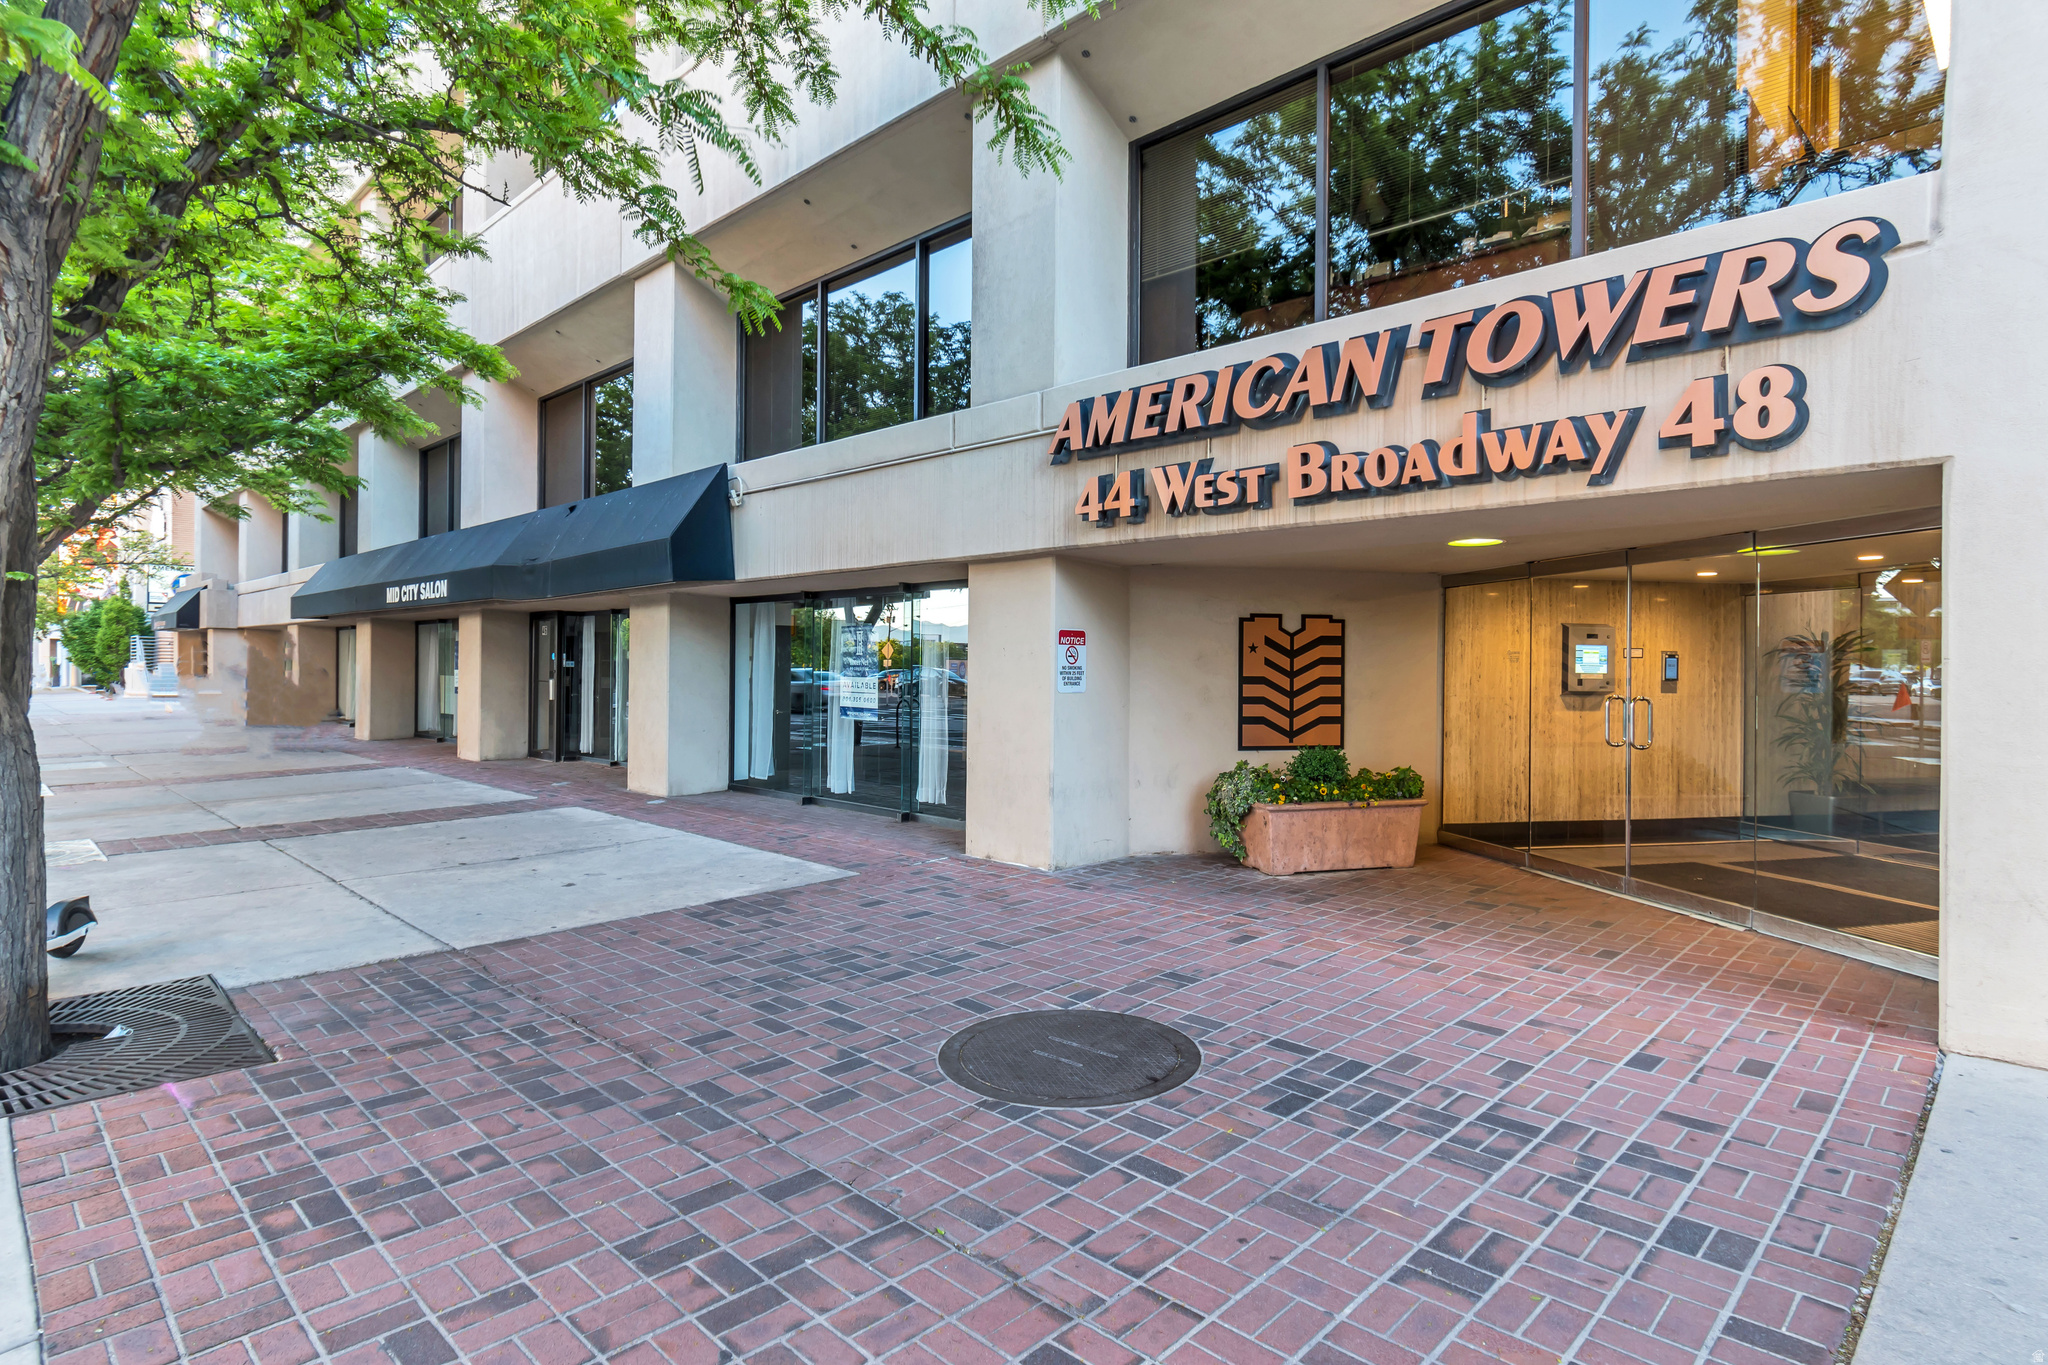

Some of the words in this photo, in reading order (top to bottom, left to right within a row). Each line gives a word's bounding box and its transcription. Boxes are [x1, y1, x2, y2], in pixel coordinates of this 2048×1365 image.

[1048, 328, 1398, 456] AMERICAN
[1419, 217, 1890, 392] TOWERS
[1074, 470, 1139, 523] 44
[1659, 364, 1802, 451] 48
[386, 586, 400, 604] MID
[401, 583, 420, 602] CITY
[420, 579, 448, 600] SALON
[1060, 636, 1085, 645] NOTICE
[843, 681, 877, 690] AVAILABLE
